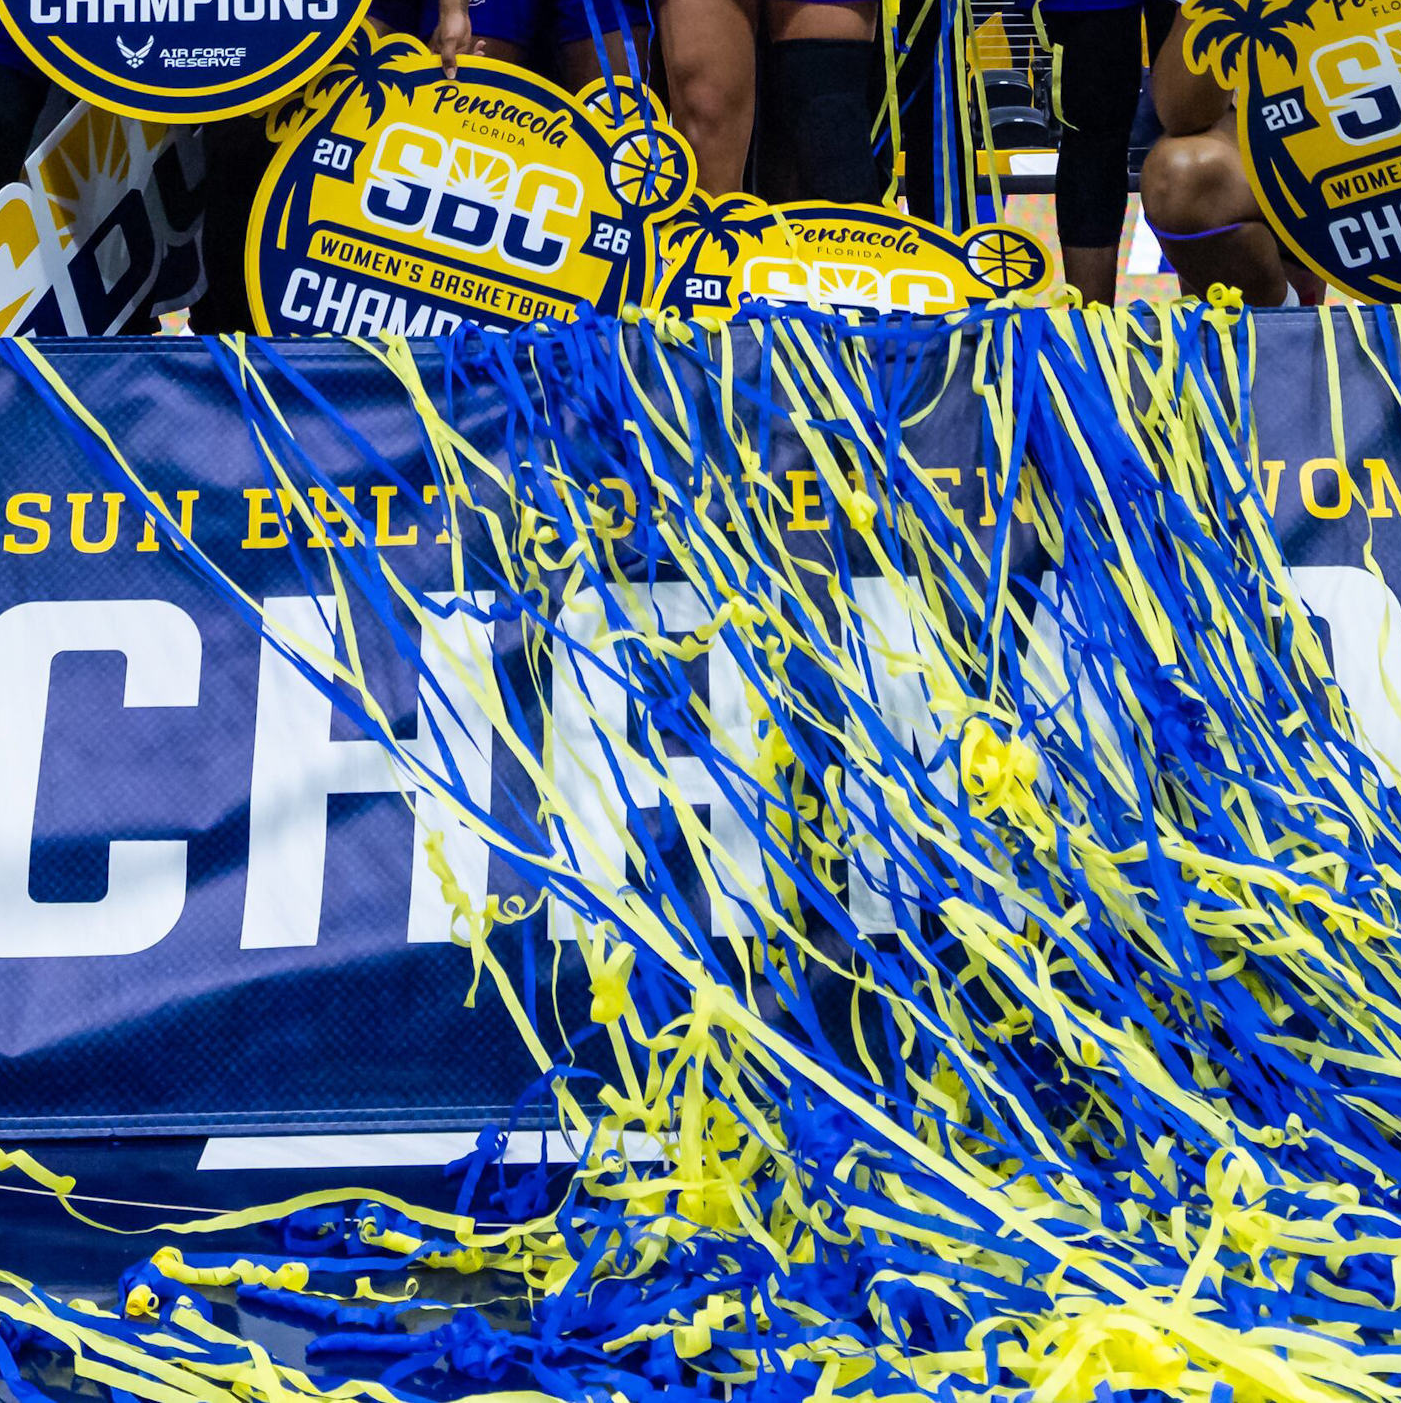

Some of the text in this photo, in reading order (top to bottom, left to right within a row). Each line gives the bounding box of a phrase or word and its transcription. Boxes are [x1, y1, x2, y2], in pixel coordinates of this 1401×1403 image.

[160, 48, 246, 58] AIR FORCE
[165, 58, 240, 67] RESERVE
[434, 85, 568, 148] Pensacola
[1261, 98, 1304, 130] 20
[313, 124, 631, 271] 20 SBC 26
[321, 237, 423, 283] WOMEN'S
[2, 488, 195, 555] SUN
[241, 485, 458, 548] BELT
